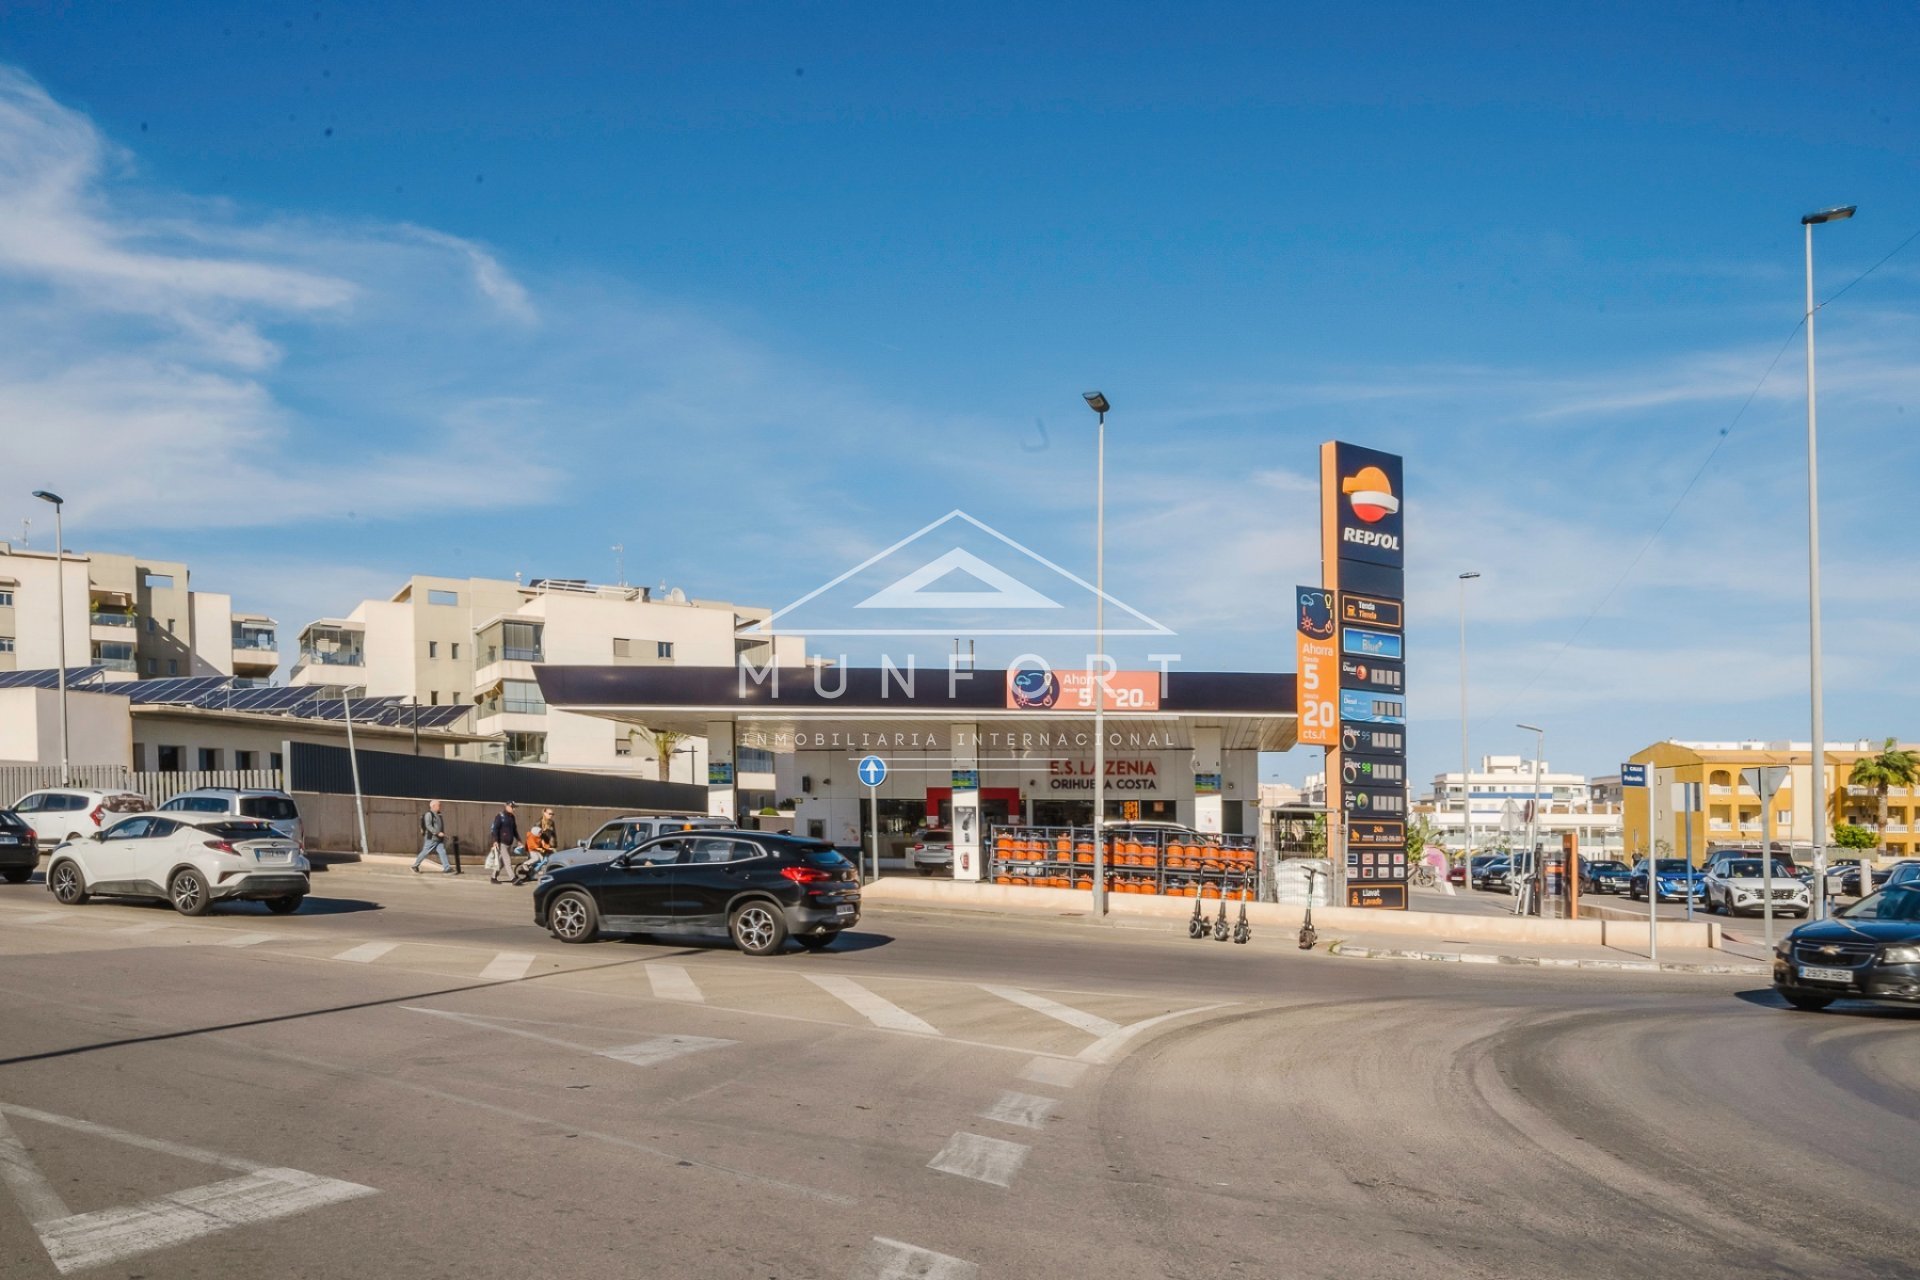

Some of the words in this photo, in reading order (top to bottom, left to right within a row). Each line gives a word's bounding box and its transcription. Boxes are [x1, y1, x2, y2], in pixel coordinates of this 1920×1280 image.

[1343, 527, 1399, 551] REPSOL
[1303, 643, 1334, 657] Ahorra
[1303, 663, 1320, 690] 5
[1115, 688, 1144, 708] 20
[1303, 700, 1335, 729] 20
[1050, 761, 1077, 775] E.S.
[1105, 761, 1157, 775] ZENIA
[1050, 779, 1113, 790] ORIHUEA
[1116, 779, 1157, 790] COSTA
